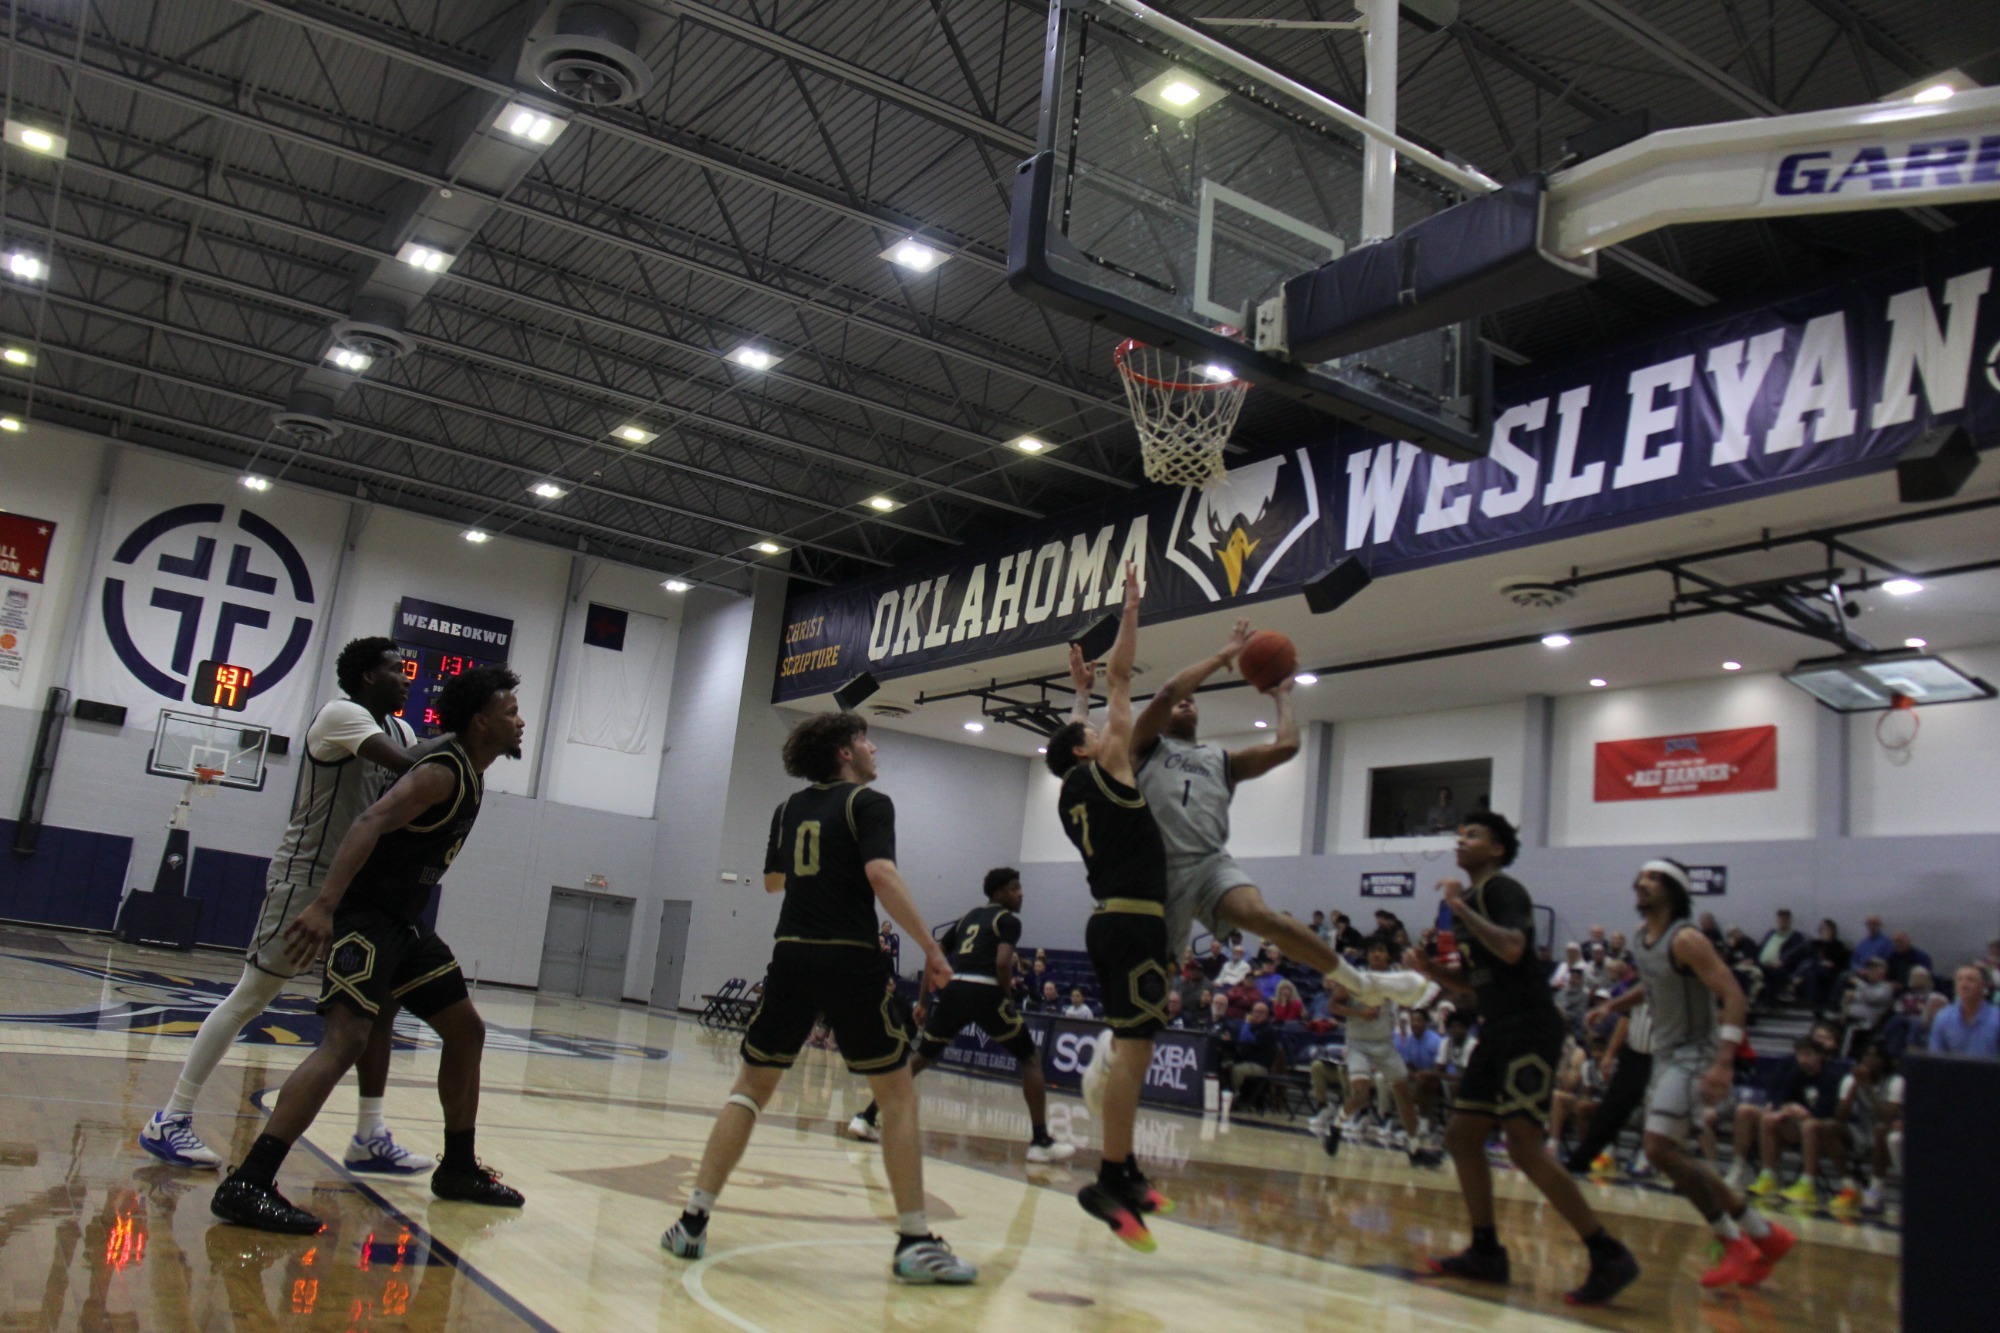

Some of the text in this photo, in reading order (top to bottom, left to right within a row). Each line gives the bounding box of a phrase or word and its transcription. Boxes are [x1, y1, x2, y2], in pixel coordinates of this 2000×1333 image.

[1345, 267, 1992, 551] WESLEYAN
[867, 514, 1148, 662] OKLAHOMA
[786, 616, 824, 644] CHRIST
[781, 645, 841, 678] SCRIPTURE
[216, 667, 249, 687] 1:31
[214, 684, 236, 707] 17
[1182, 779, 1192, 807] 1
[1068, 803, 1095, 857] 7
[794, 820, 821, 877] 0
[959, 924, 980, 954] 2
[988, 1053, 1017, 1072] EAGLES
